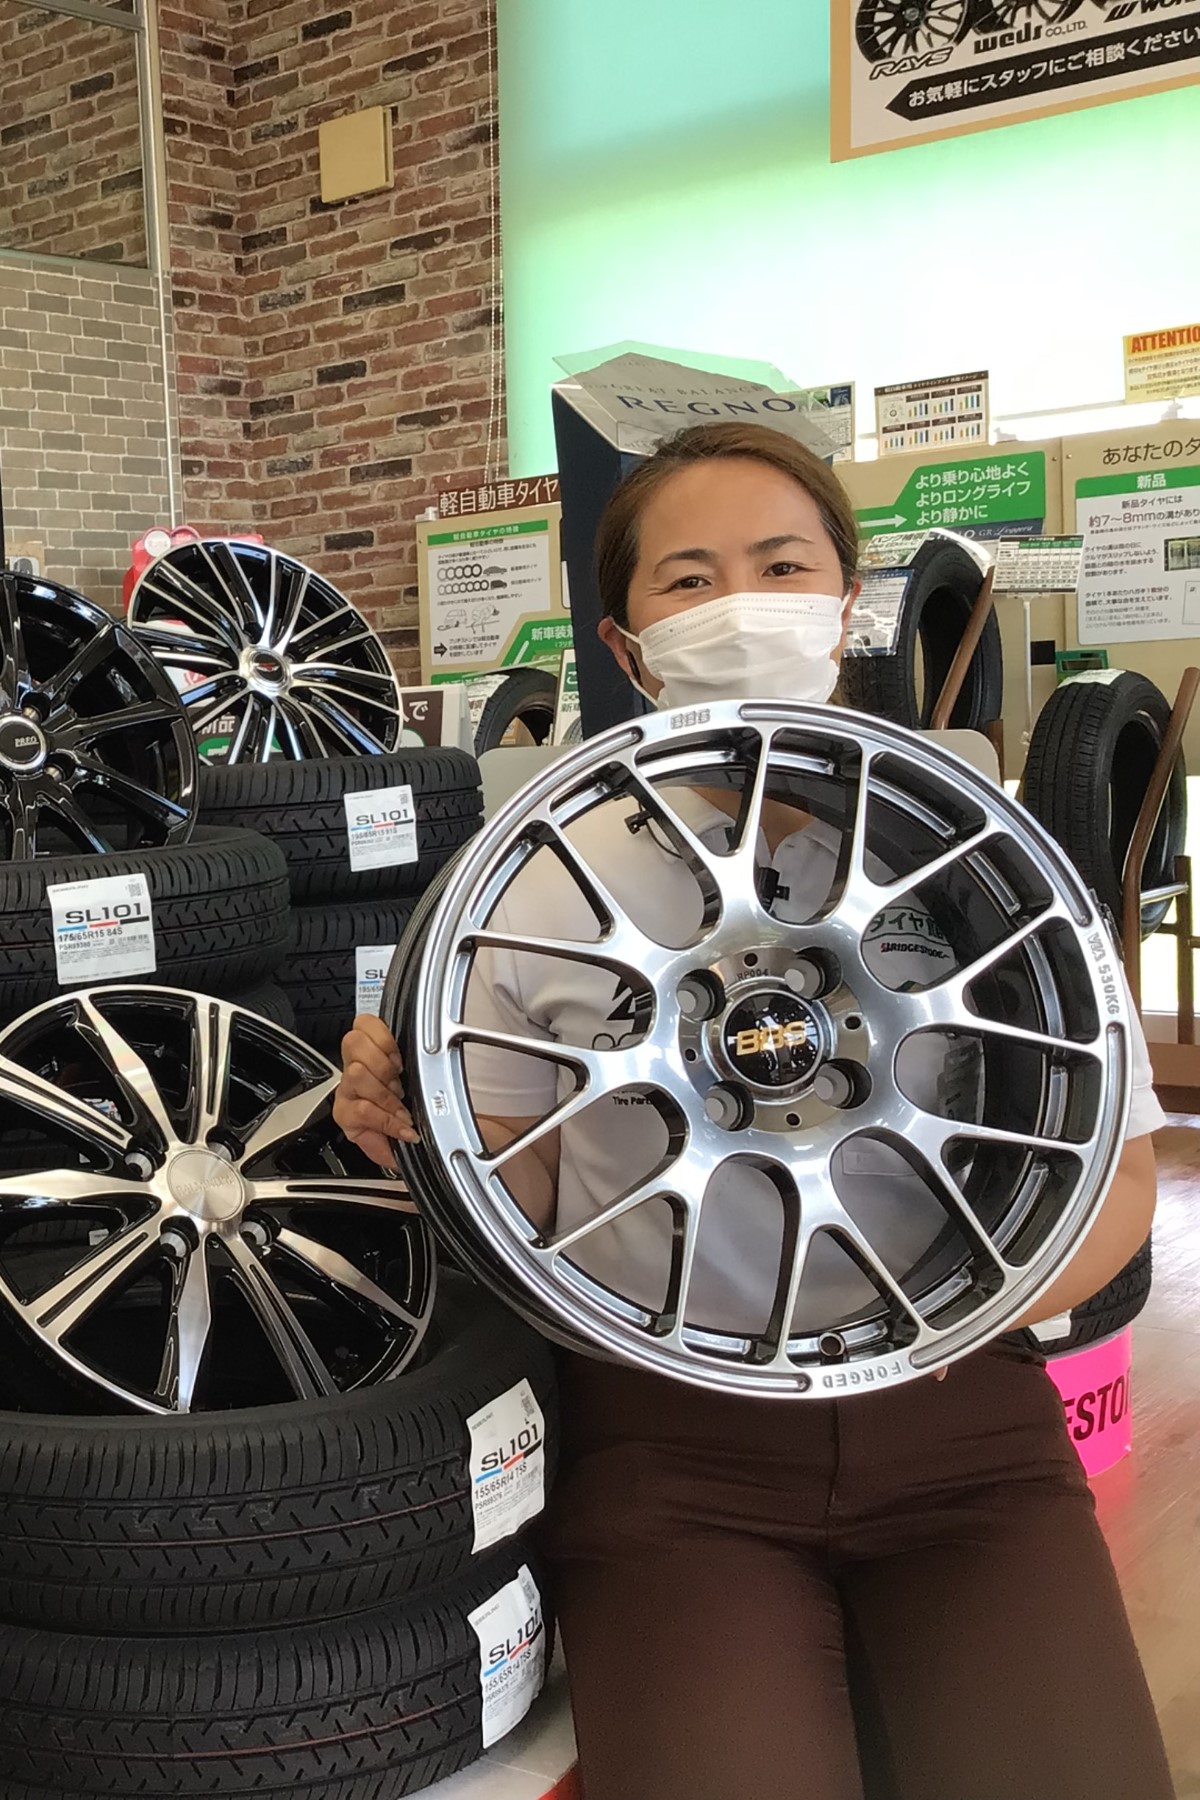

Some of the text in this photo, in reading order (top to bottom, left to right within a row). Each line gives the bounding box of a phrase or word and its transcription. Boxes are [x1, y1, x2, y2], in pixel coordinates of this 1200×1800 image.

[869, 47, 954, 80] RAYS
[908, 26, 1200, 107] お気軽にスタッフにご相談ください
[615, 395, 797, 416] REGNO
[915, 461, 1030, 490] より乗り心地よく
[1136, 472, 1167, 489] 新品
[440, 477, 559, 516] 軽自動車タイヤ
[915, 480, 1031, 508] よりロングライフ
[1121, 495, 1182, 509] 新品タイヤには
[916, 505, 989, 526] より静かに
[671, 708, 711, 730] BBS
[355, 809, 409, 826] SL101
[64, 902, 142, 924] SL101
[1098, 963, 1120, 1015] 530KG
[736, 1020, 806, 1056] BBS
[822, 1360, 903, 1389] FORGED
[481, 1423, 540, 1472] SL101
